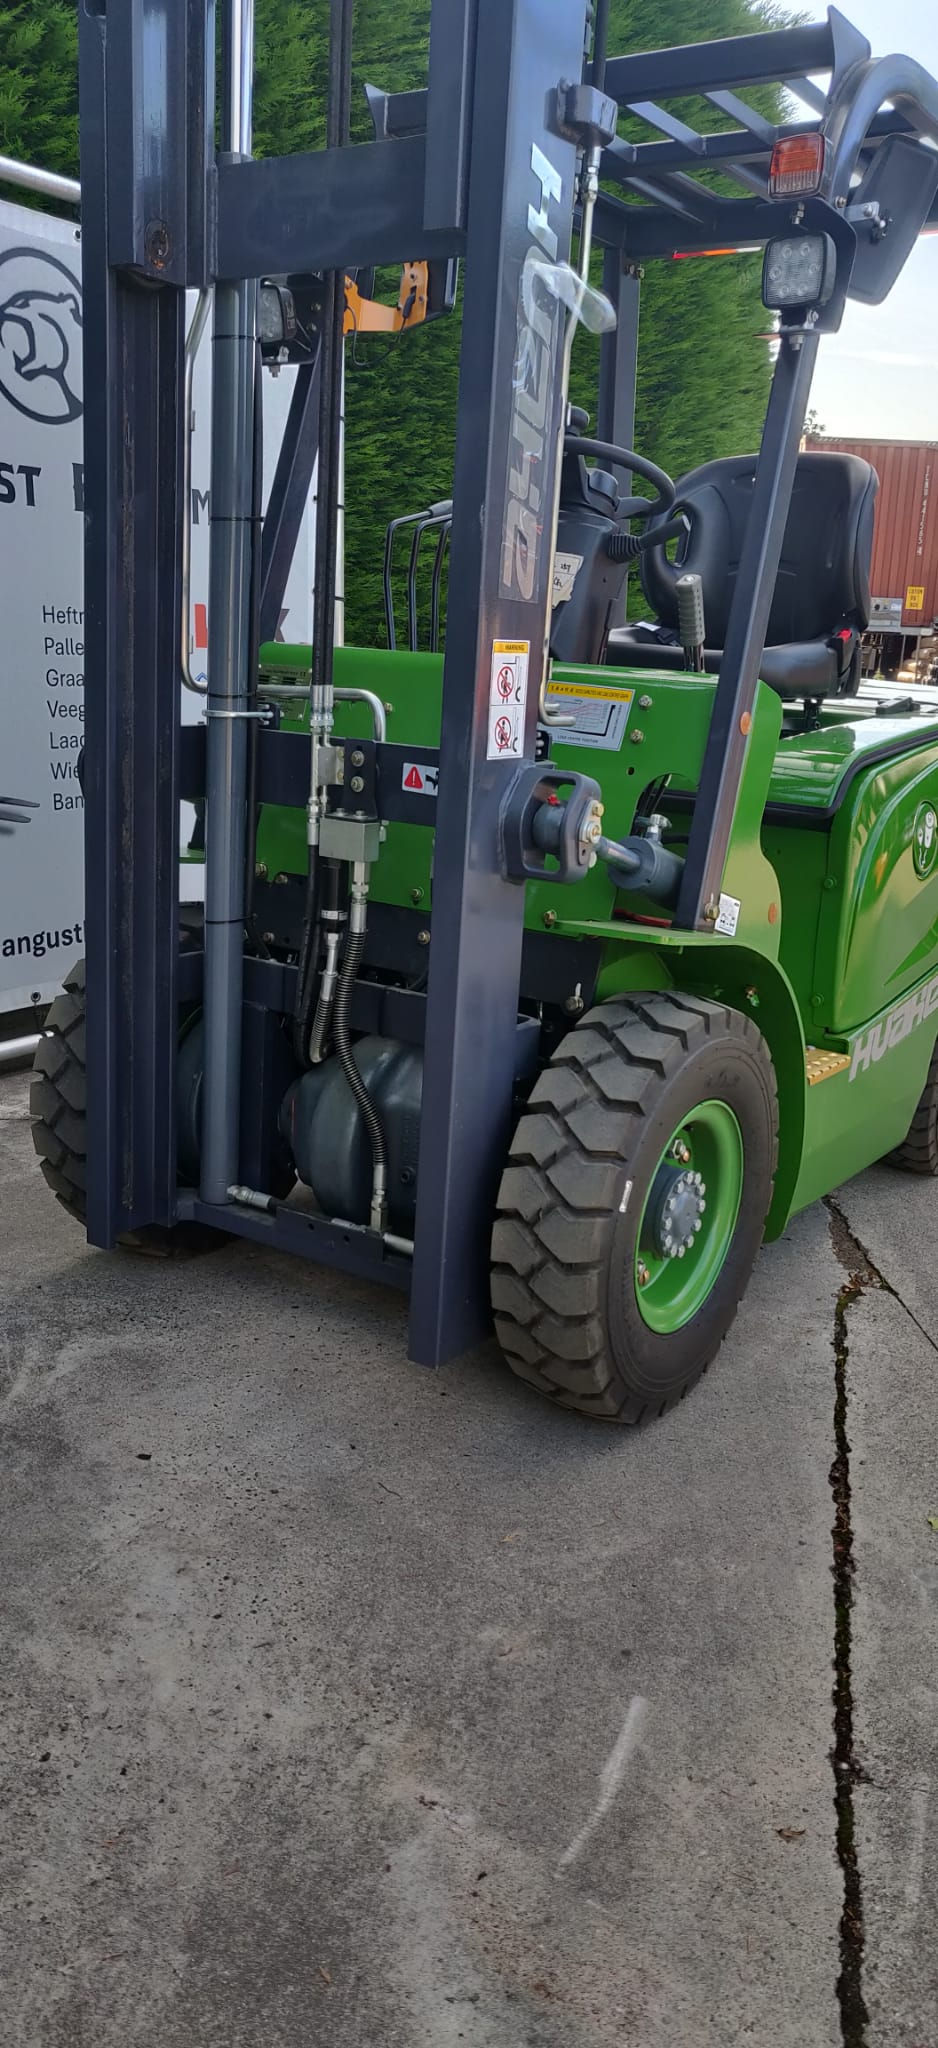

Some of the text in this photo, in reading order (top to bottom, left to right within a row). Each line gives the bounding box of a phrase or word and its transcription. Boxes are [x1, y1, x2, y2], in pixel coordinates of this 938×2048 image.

[44, 637, 84, 656] Palle
[46, 668, 84, 687] Graa
[53, 792, 84, 811] Ban
[2, 923, 84, 957] angust
